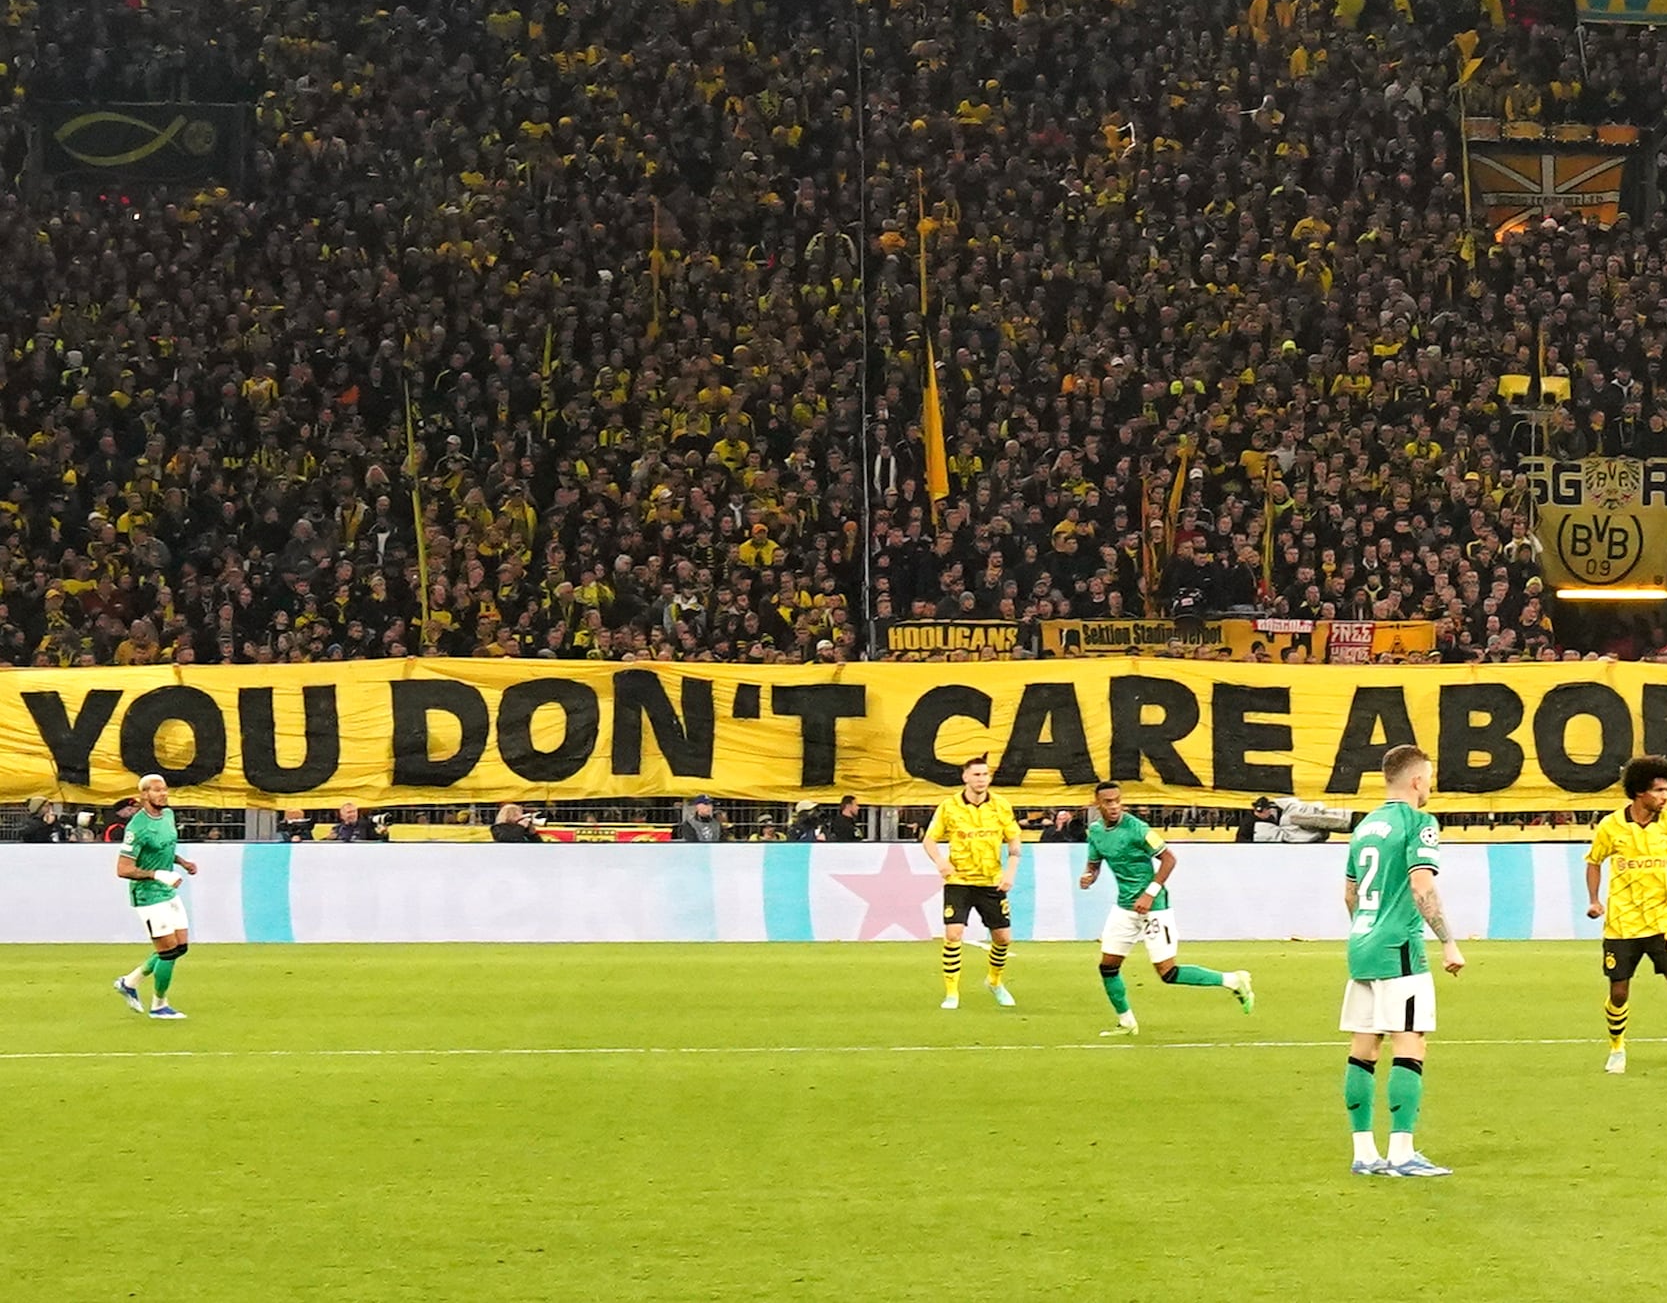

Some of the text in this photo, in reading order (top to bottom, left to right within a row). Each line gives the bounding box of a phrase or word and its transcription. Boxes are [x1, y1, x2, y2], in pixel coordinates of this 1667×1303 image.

[1572, 514, 1629, 560] BVB
[1586, 559, 1611, 576] 09
[887, 627, 1018, 651] HOOLIGANS
[1332, 623, 1372, 642] FREE
[20, 684, 340, 793] YOU
[389, 669, 866, 789] DON'T
[901, 674, 1294, 794] CARE
[1357, 846, 1380, 911] 2
